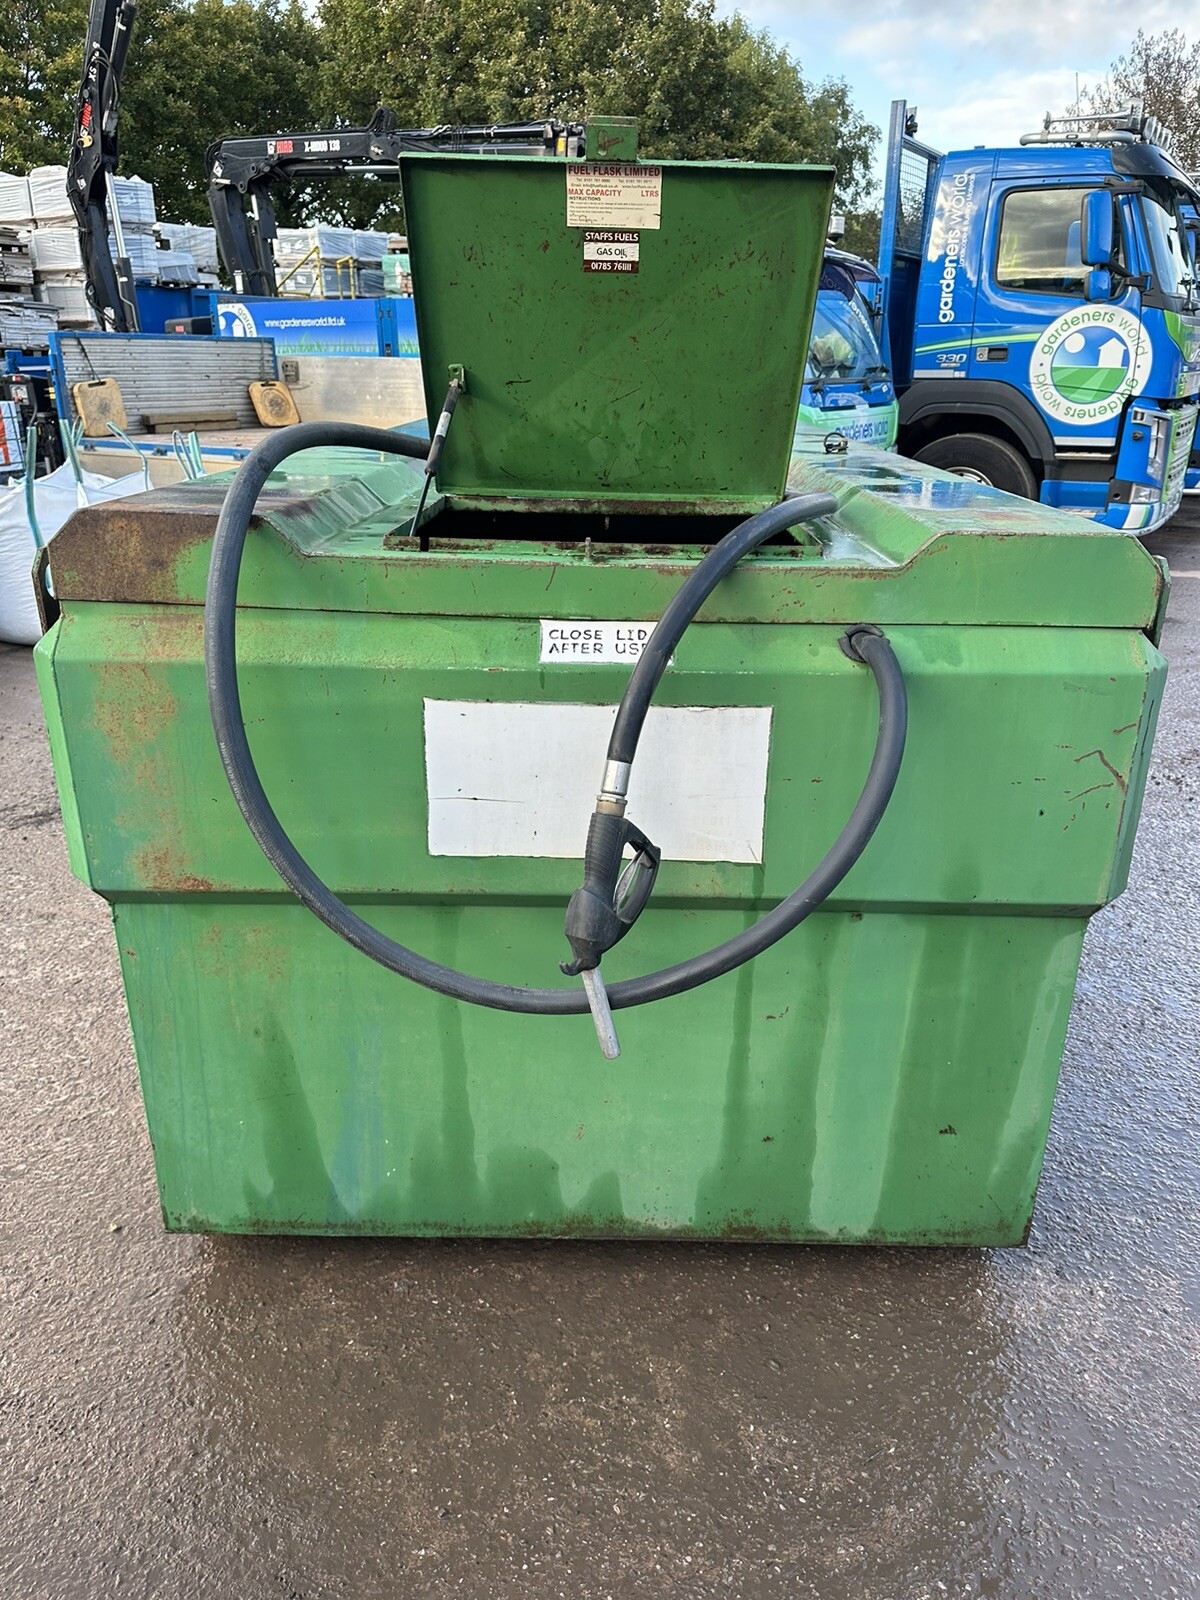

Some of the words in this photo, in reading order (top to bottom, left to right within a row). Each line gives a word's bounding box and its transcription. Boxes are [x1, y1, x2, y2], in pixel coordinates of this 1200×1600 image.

[276, 140, 294, 154] HIAB
[568, 165, 590, 175] FUEL
[593, 166, 622, 176] FLASK
[624, 166, 661, 177] LIMITED
[568, 188, 584, 196] MAX
[586, 189, 622, 197] CAPACITY
[641, 190, 659, 198] LTRS
[585, 231, 613, 241] STAFFS
[614, 232, 639, 242] FUELS
[596, 247, 613, 256] GAS
[614, 248, 627, 257] OIL
[939, 229, 961, 323] gardeners
[950, 173, 968, 225] world
[591, 261, 611, 270] 01785
[1041, 310, 1116, 356] gardeners
[1118, 316, 1148, 357] world
[935, 353, 967, 364] 330
[1034, 373, 1062, 412] world
[1063, 377, 1139, 419] gardeners
[548, 629, 603, 641] CLOSE
[616, 629, 648, 641] LID
[548, 642, 604, 654] AFTER
